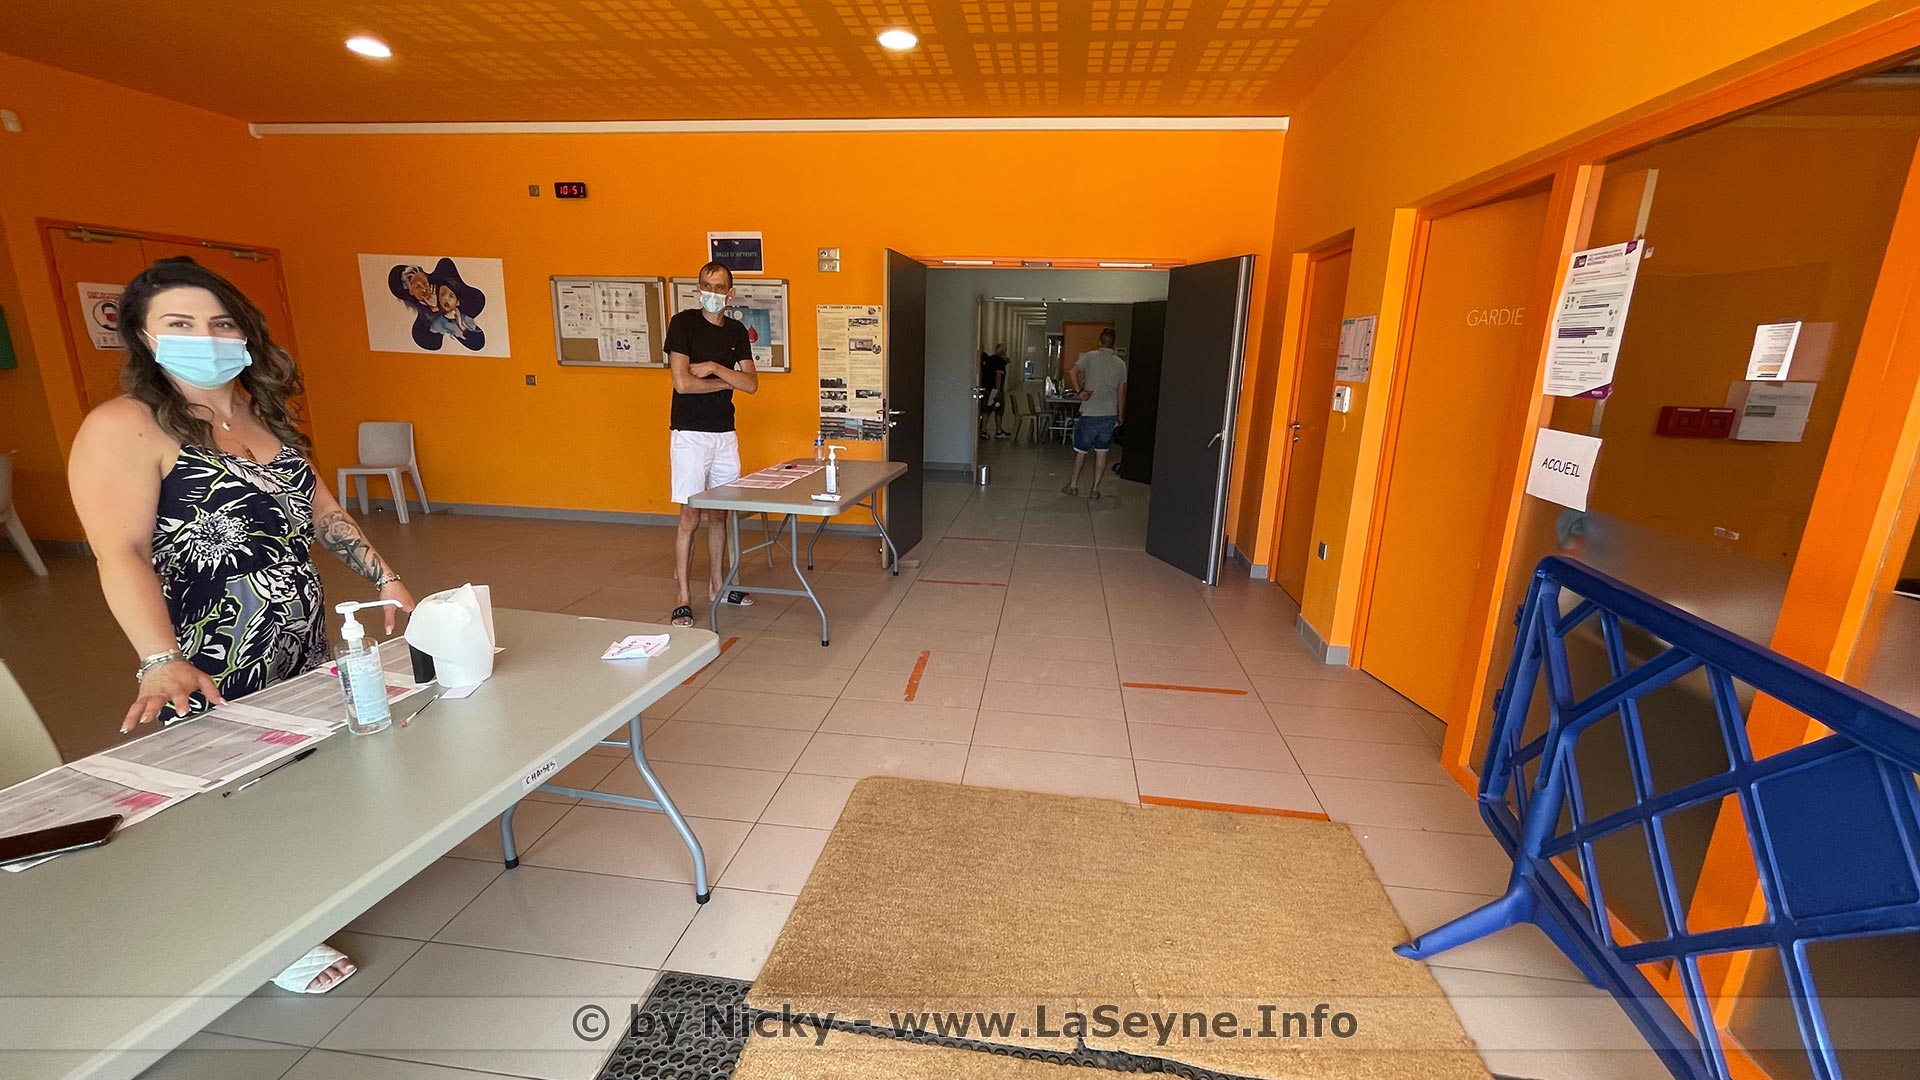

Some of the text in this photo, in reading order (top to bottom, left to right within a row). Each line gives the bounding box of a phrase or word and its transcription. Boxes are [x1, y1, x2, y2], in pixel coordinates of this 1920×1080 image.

[560, 185, 583, 195] 10:51
[1466, 307, 1526, 327] GARDIE
[1541, 457, 1580, 478] ACCUEIL
[525, 761, 556, 785] CHAISES
